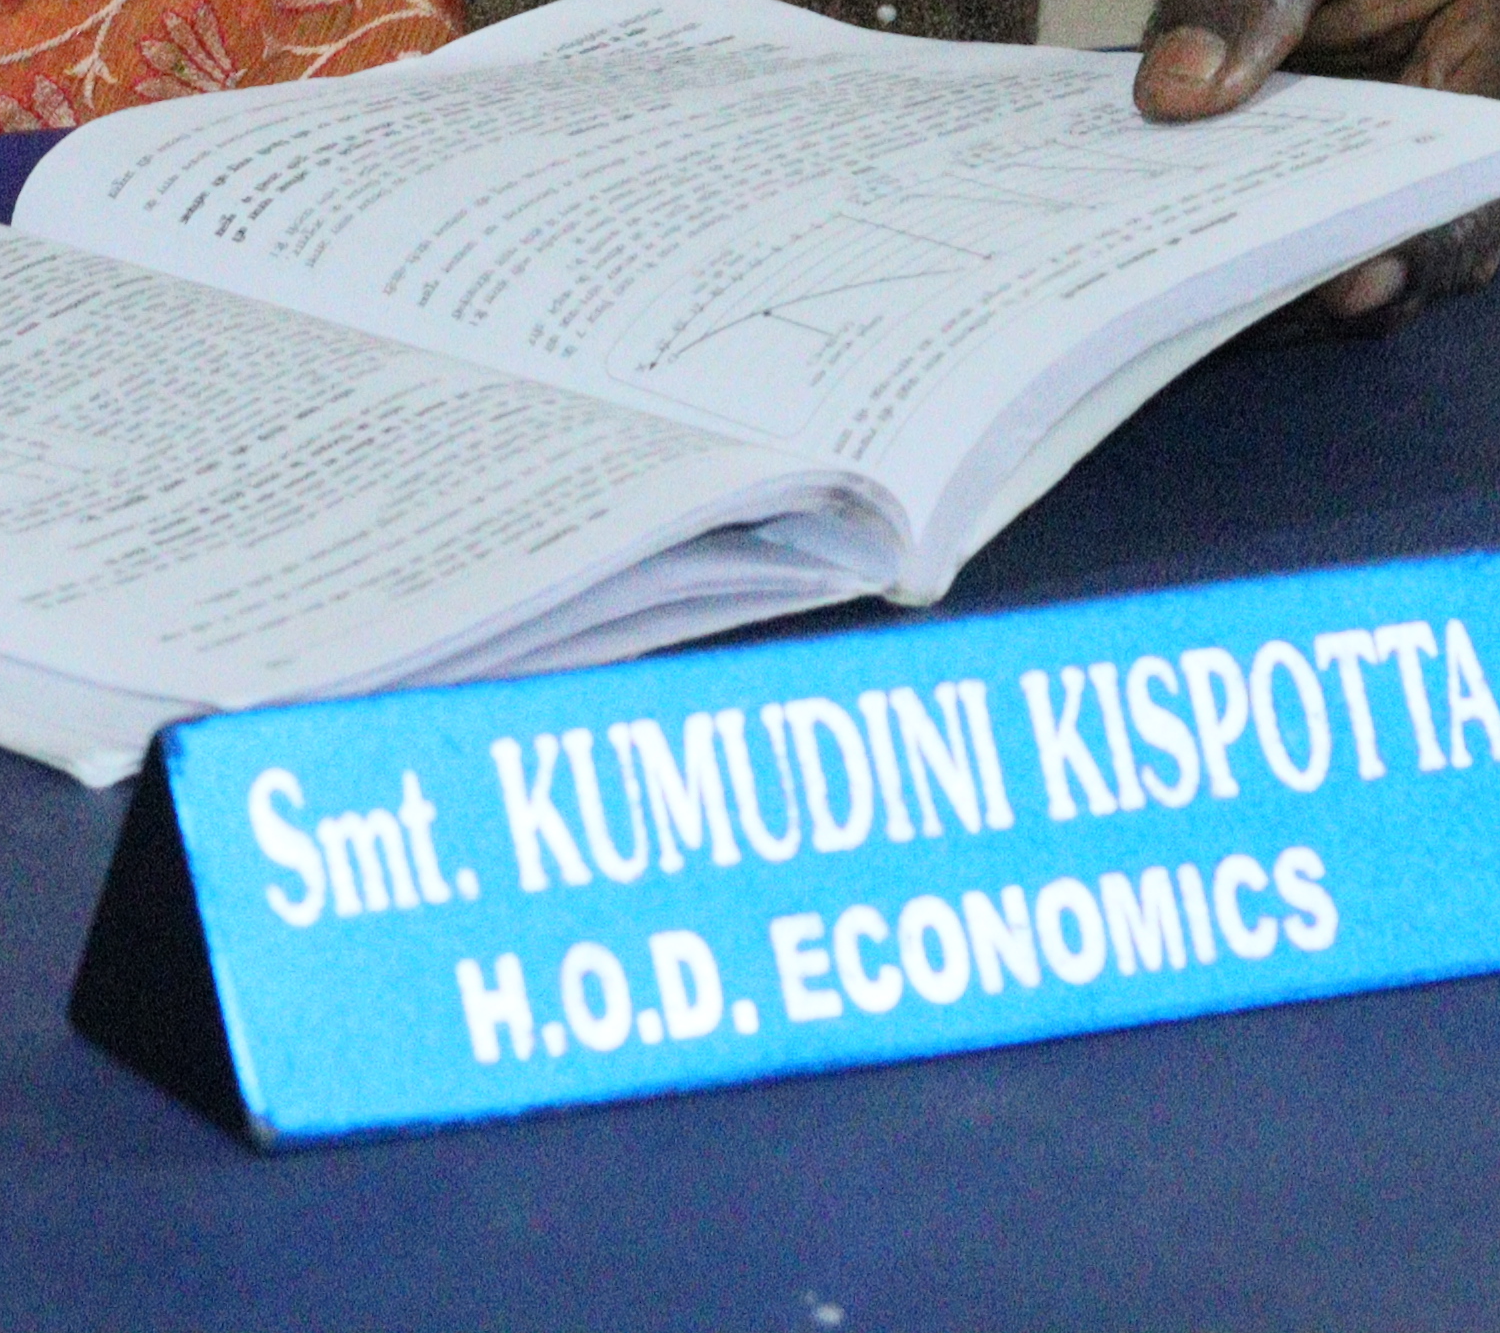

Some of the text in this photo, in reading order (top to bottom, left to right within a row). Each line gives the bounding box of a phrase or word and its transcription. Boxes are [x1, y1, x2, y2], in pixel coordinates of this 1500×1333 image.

[246, 765, 482, 930] Smt.
[489, 677, 1015, 895] KUMUDINI
[454, 844, 1341, 1066] H.O.D. ECONOMICS
